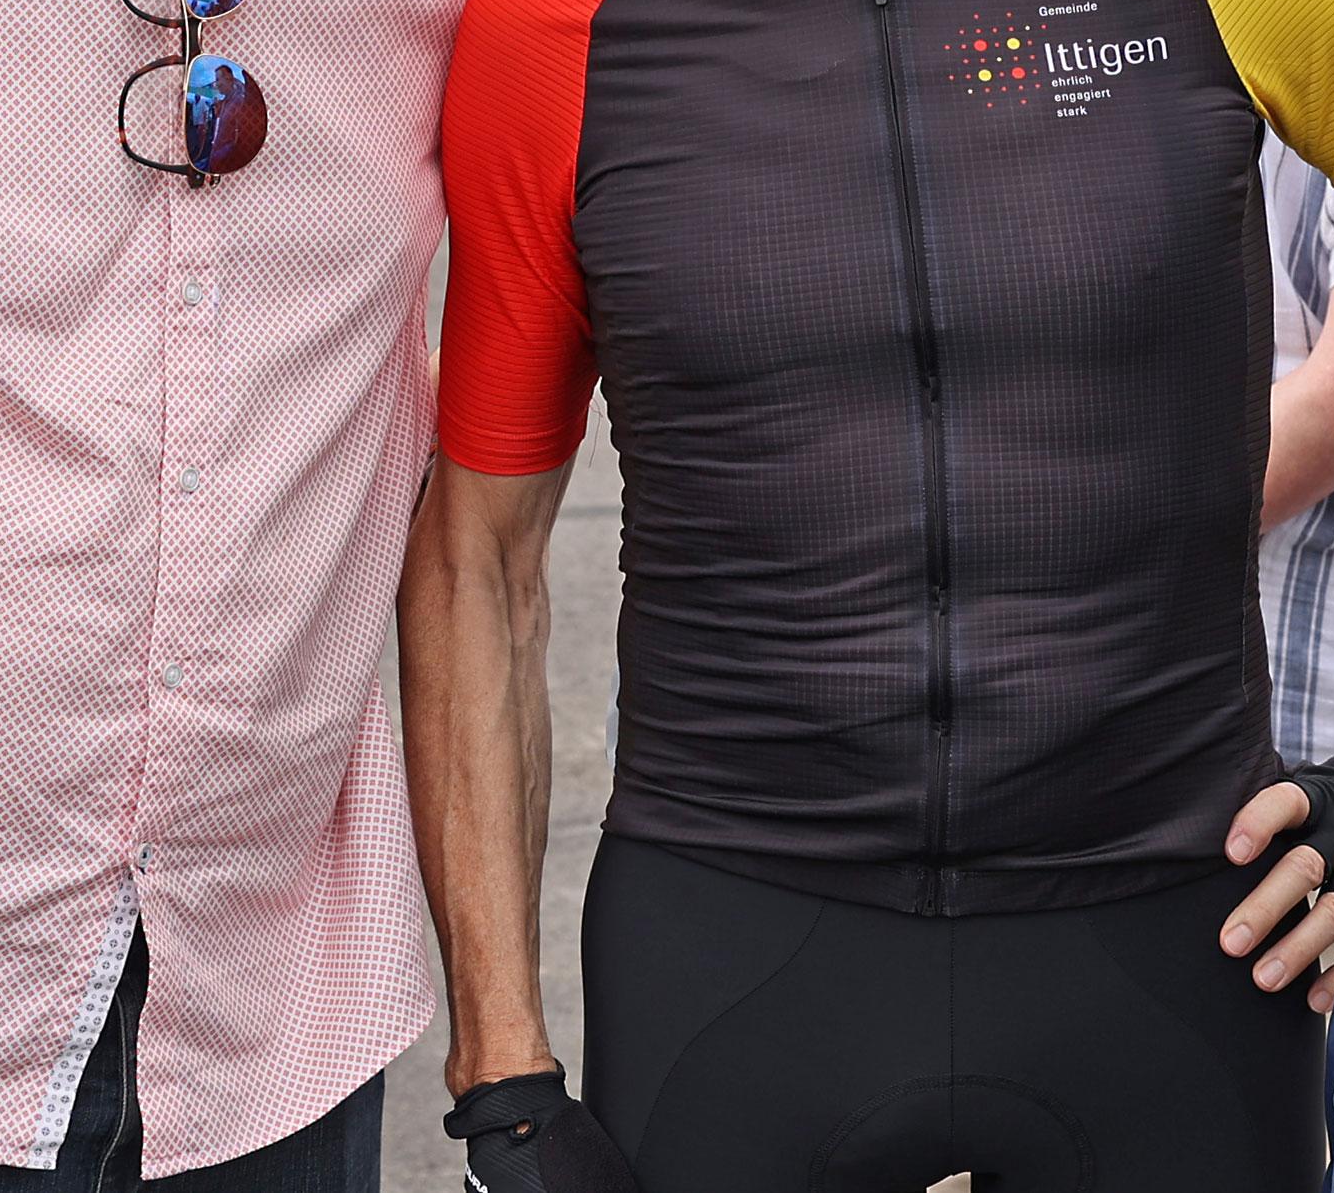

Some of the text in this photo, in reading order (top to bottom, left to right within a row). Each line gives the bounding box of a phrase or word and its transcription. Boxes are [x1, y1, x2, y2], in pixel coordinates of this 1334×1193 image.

[1038, 1, 1099, 17] Gemeinde
[1044, 36, 1168, 76] Ittigen
[1051, 74, 1093, 87] ehrlich
[1054, 89, 1112, 103] engagiert
[1056, 105, 1088, 118] stark
